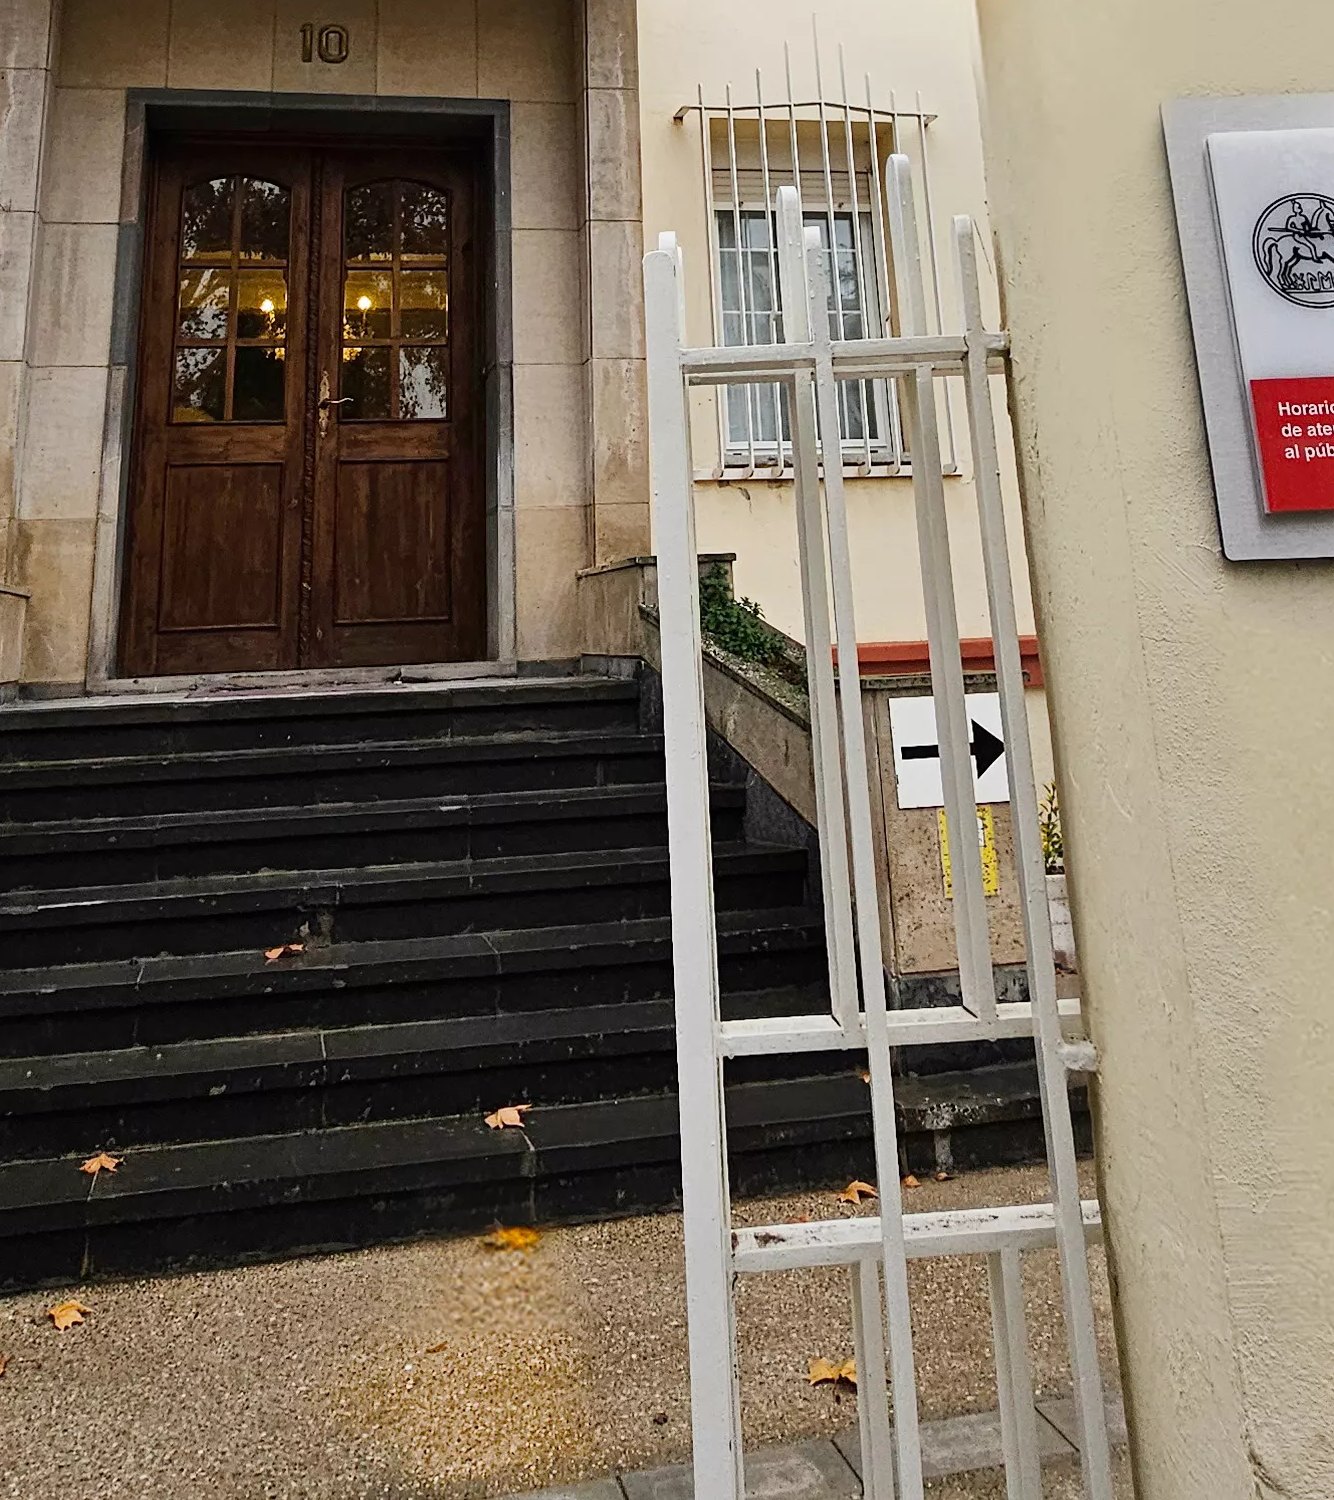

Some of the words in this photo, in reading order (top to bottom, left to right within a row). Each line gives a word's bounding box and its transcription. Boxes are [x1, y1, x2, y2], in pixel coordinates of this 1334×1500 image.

[299, 22, 350, 64] 10
[1281, 423, 1302, 437] de
[1284, 444, 1300, 459] al
